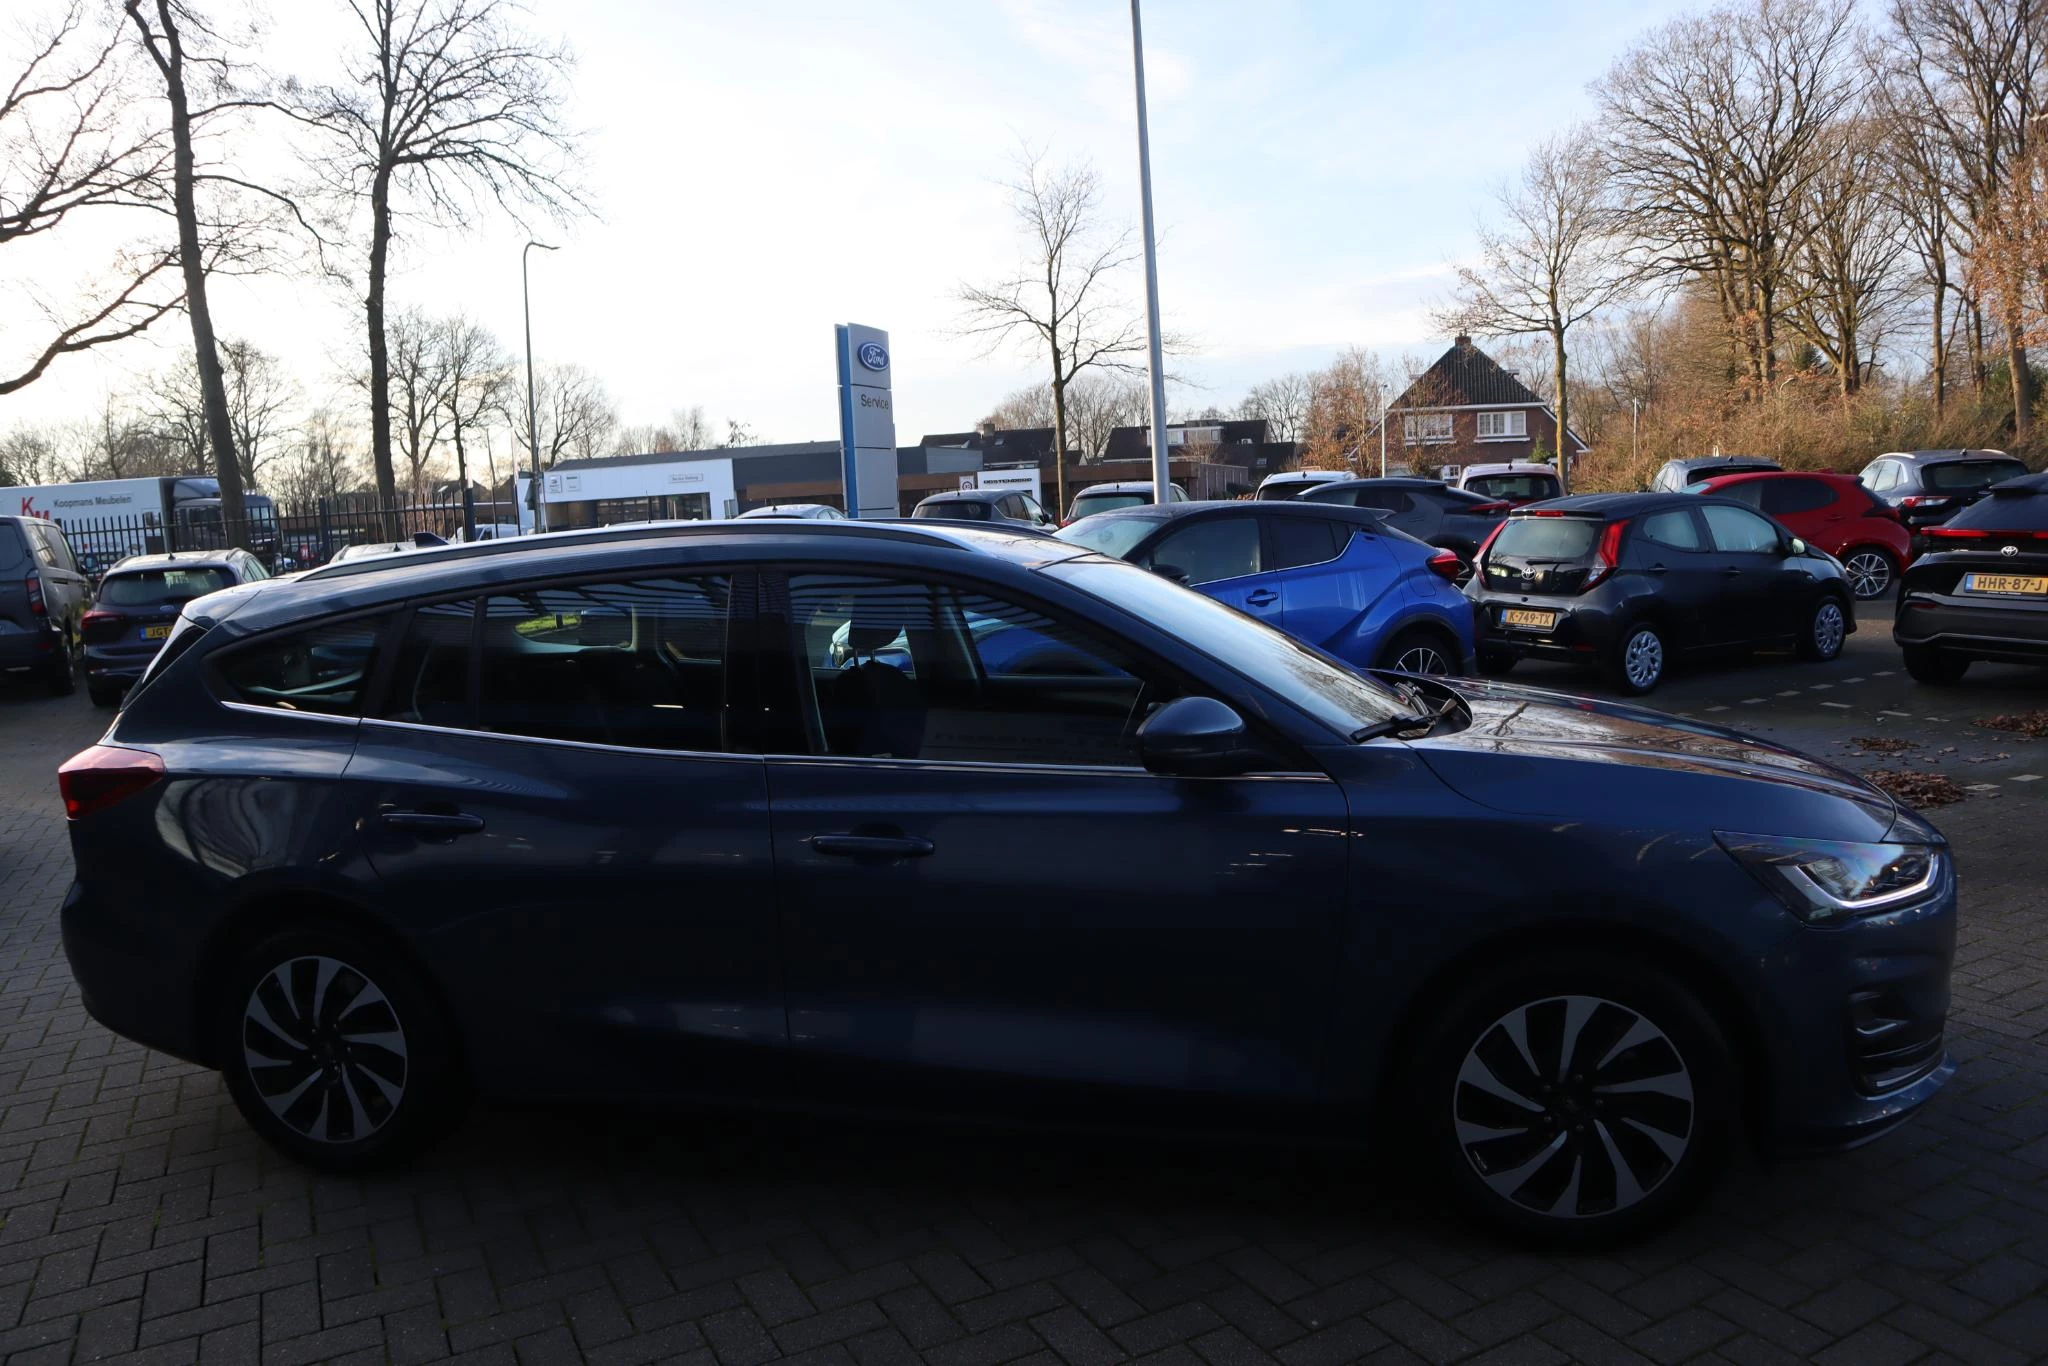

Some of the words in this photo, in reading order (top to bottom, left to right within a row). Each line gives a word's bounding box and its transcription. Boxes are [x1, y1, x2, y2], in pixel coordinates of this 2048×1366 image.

[866, 345, 886, 367] Ford
[860, 393, 889, 409] Service
[53, 498, 93, 509] Koopmans
[1977, 576, 2042, 592] HHR-87-J
[1508, 611, 1551, 625] K-749-TX
